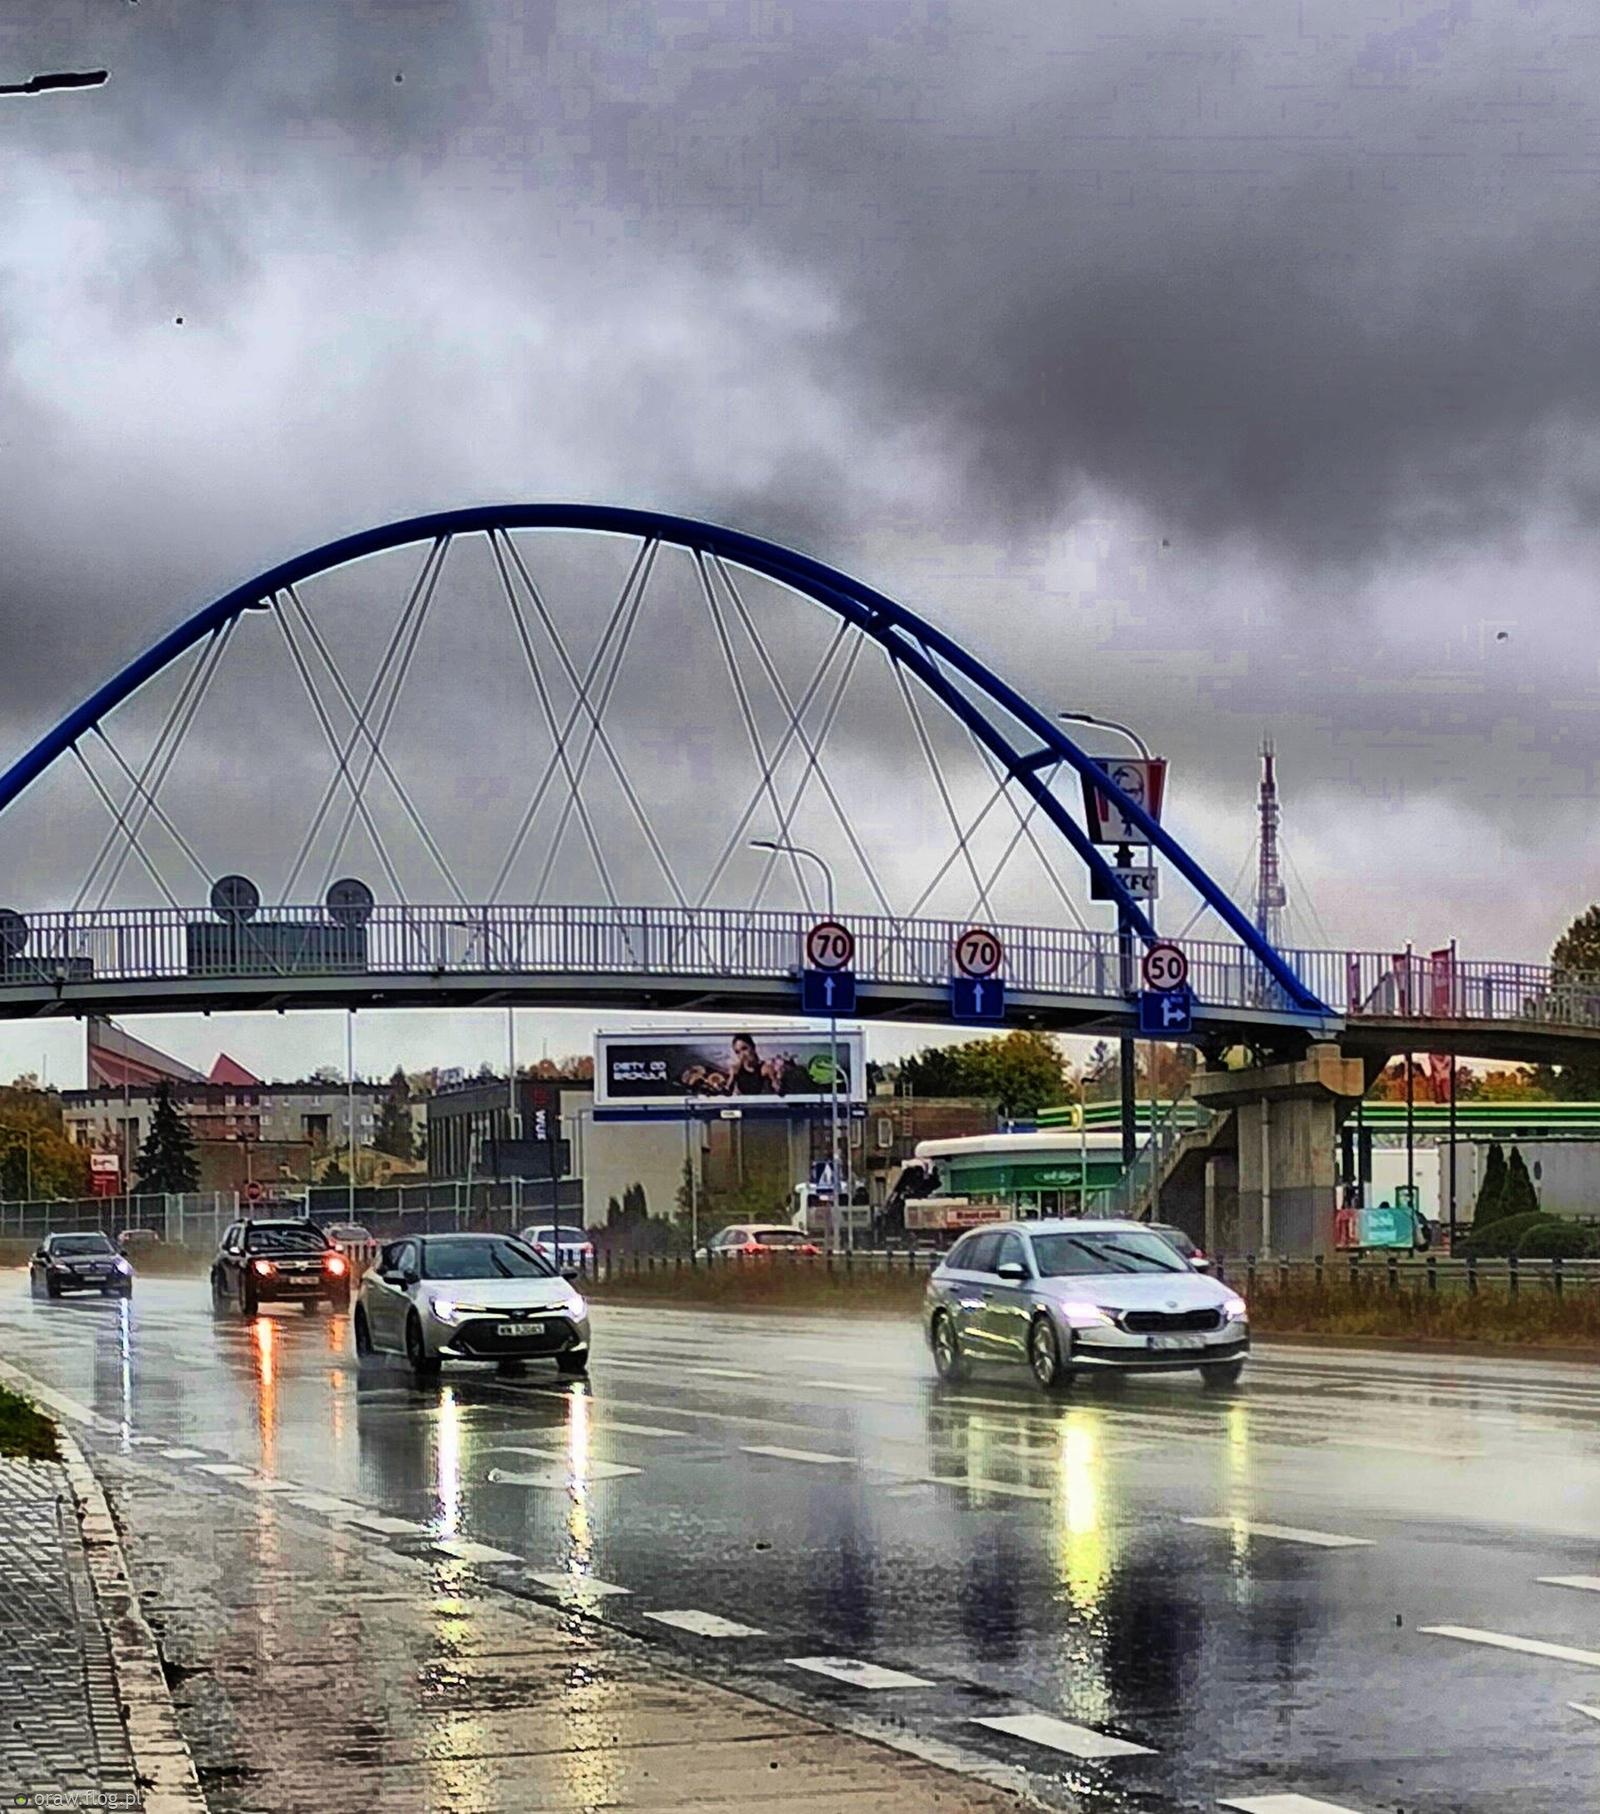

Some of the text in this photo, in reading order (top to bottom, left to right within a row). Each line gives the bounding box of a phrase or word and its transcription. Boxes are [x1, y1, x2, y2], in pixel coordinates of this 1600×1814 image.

[1116, 874, 1155, 891] KFC
[817, 934, 847, 959] 70
[966, 941, 996, 966] 70
[1151, 956, 1182, 980] 50
